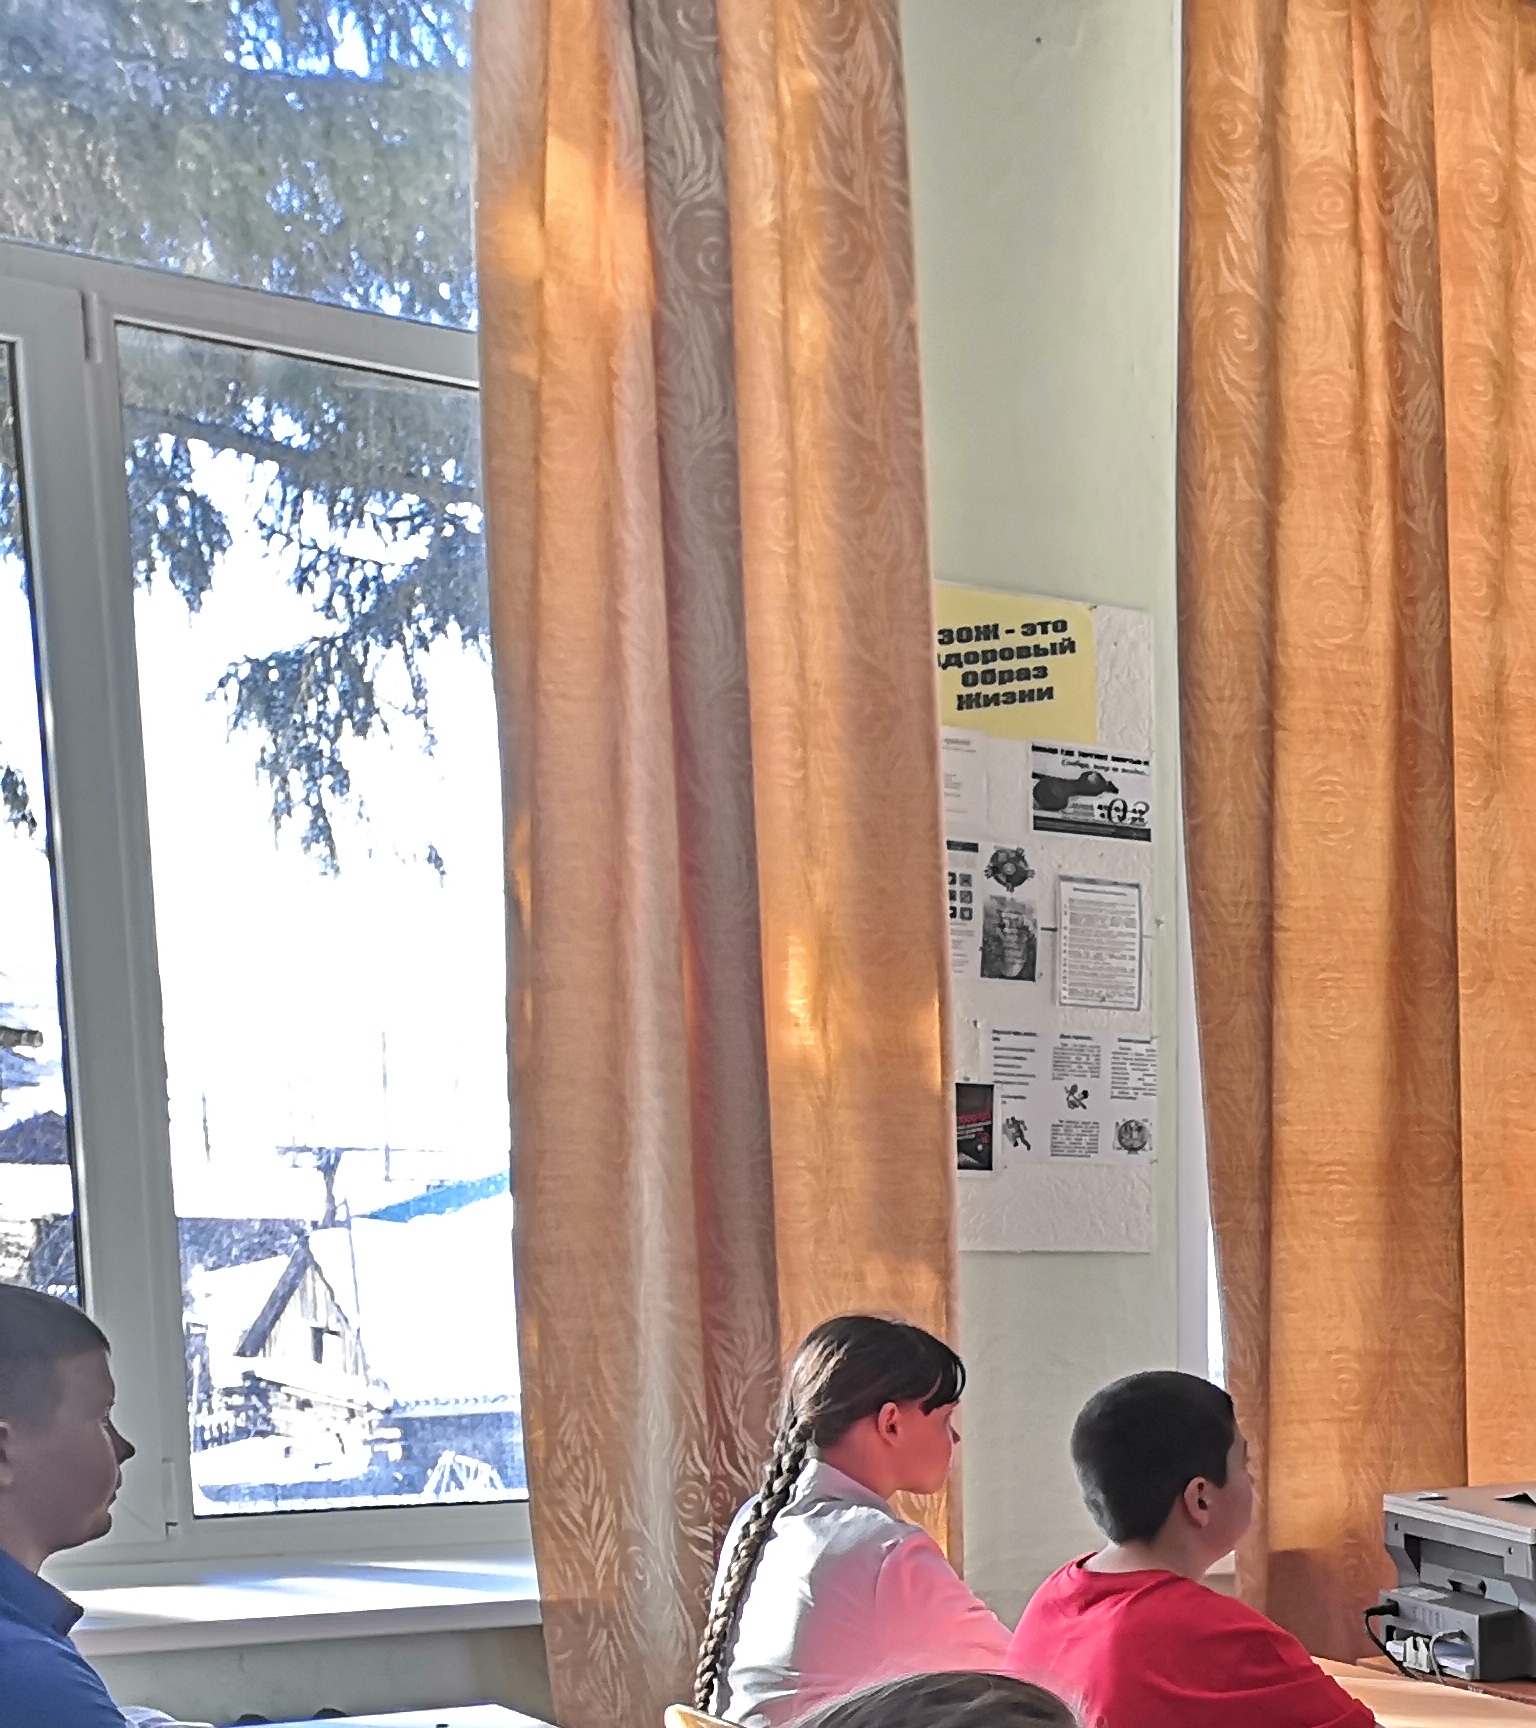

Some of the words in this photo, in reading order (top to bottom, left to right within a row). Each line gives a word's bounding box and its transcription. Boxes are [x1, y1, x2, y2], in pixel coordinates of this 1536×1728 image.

[938, 623, 999, 646] ЗОЖ
[1021, 619, 1068, 637] это
[938, 637, 1076, 669] доровый
